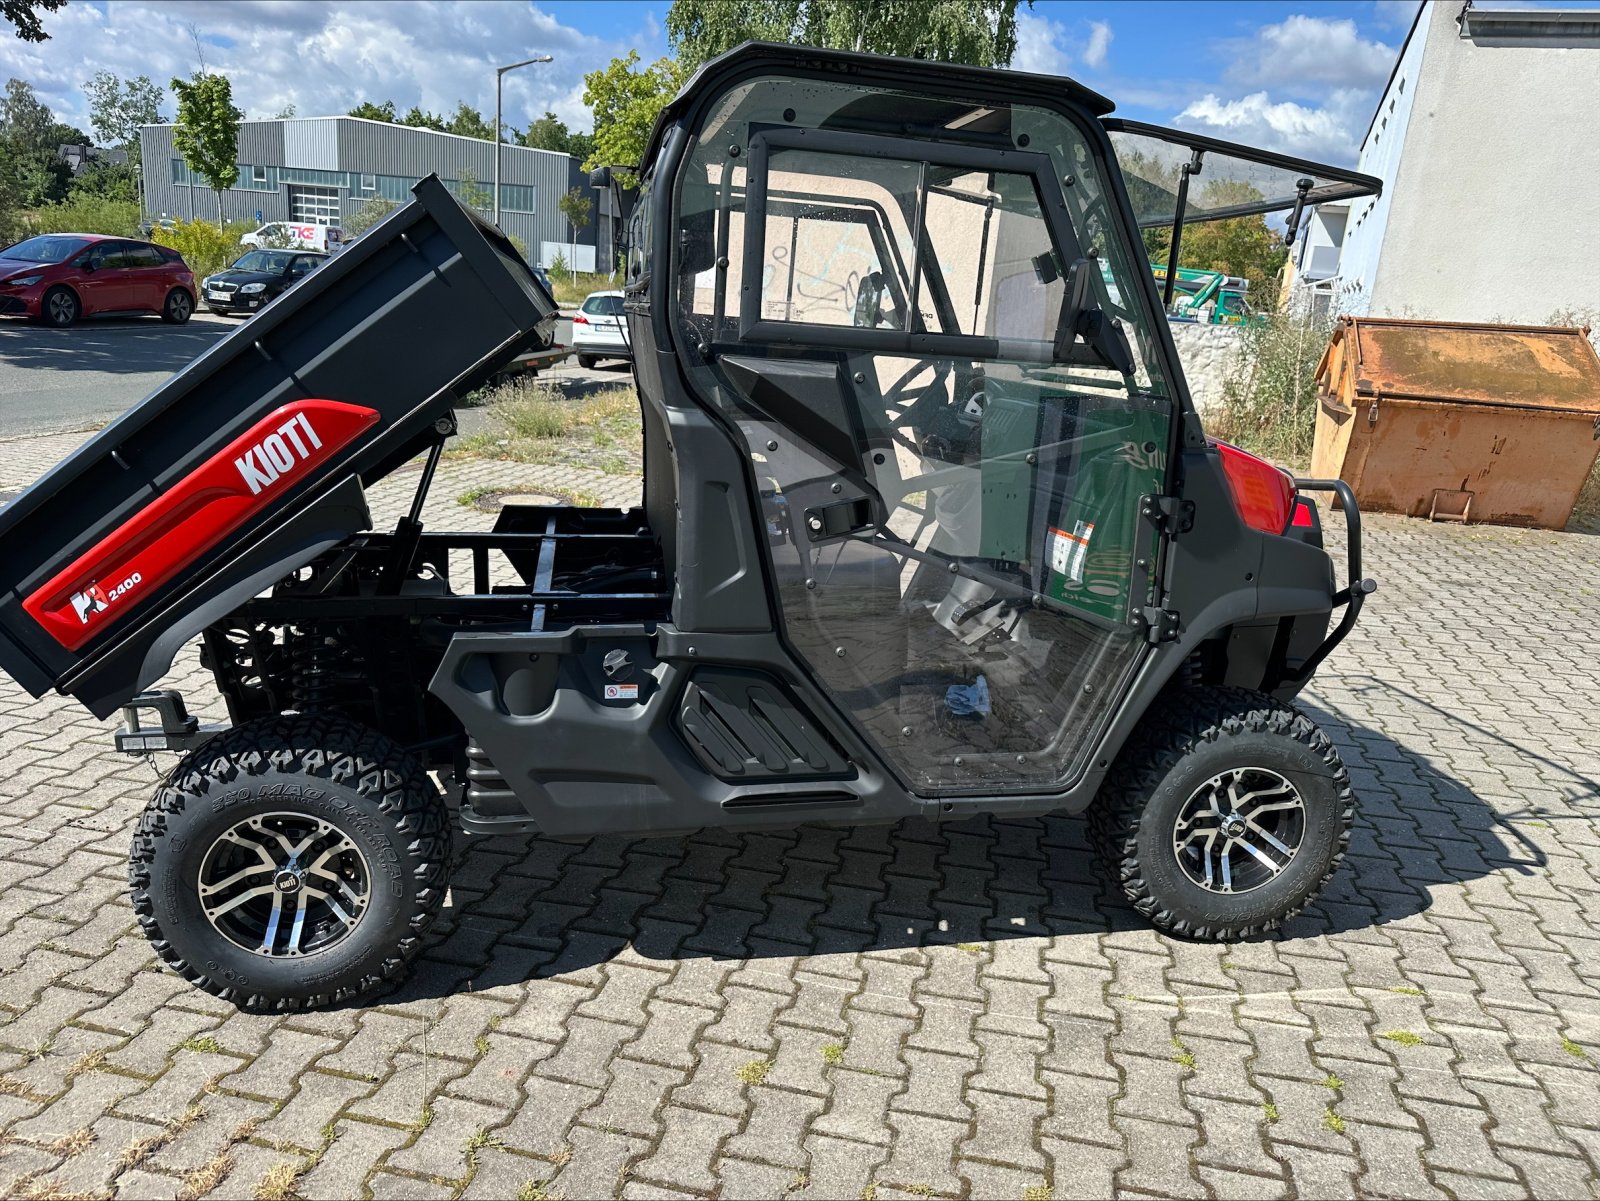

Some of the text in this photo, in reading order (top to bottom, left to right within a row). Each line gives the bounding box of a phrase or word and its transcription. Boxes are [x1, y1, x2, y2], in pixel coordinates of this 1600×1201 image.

[234, 411, 323, 496] KIOTI
[108, 572, 142, 602] 2400
[279, 874, 296, 889] KIOTI
